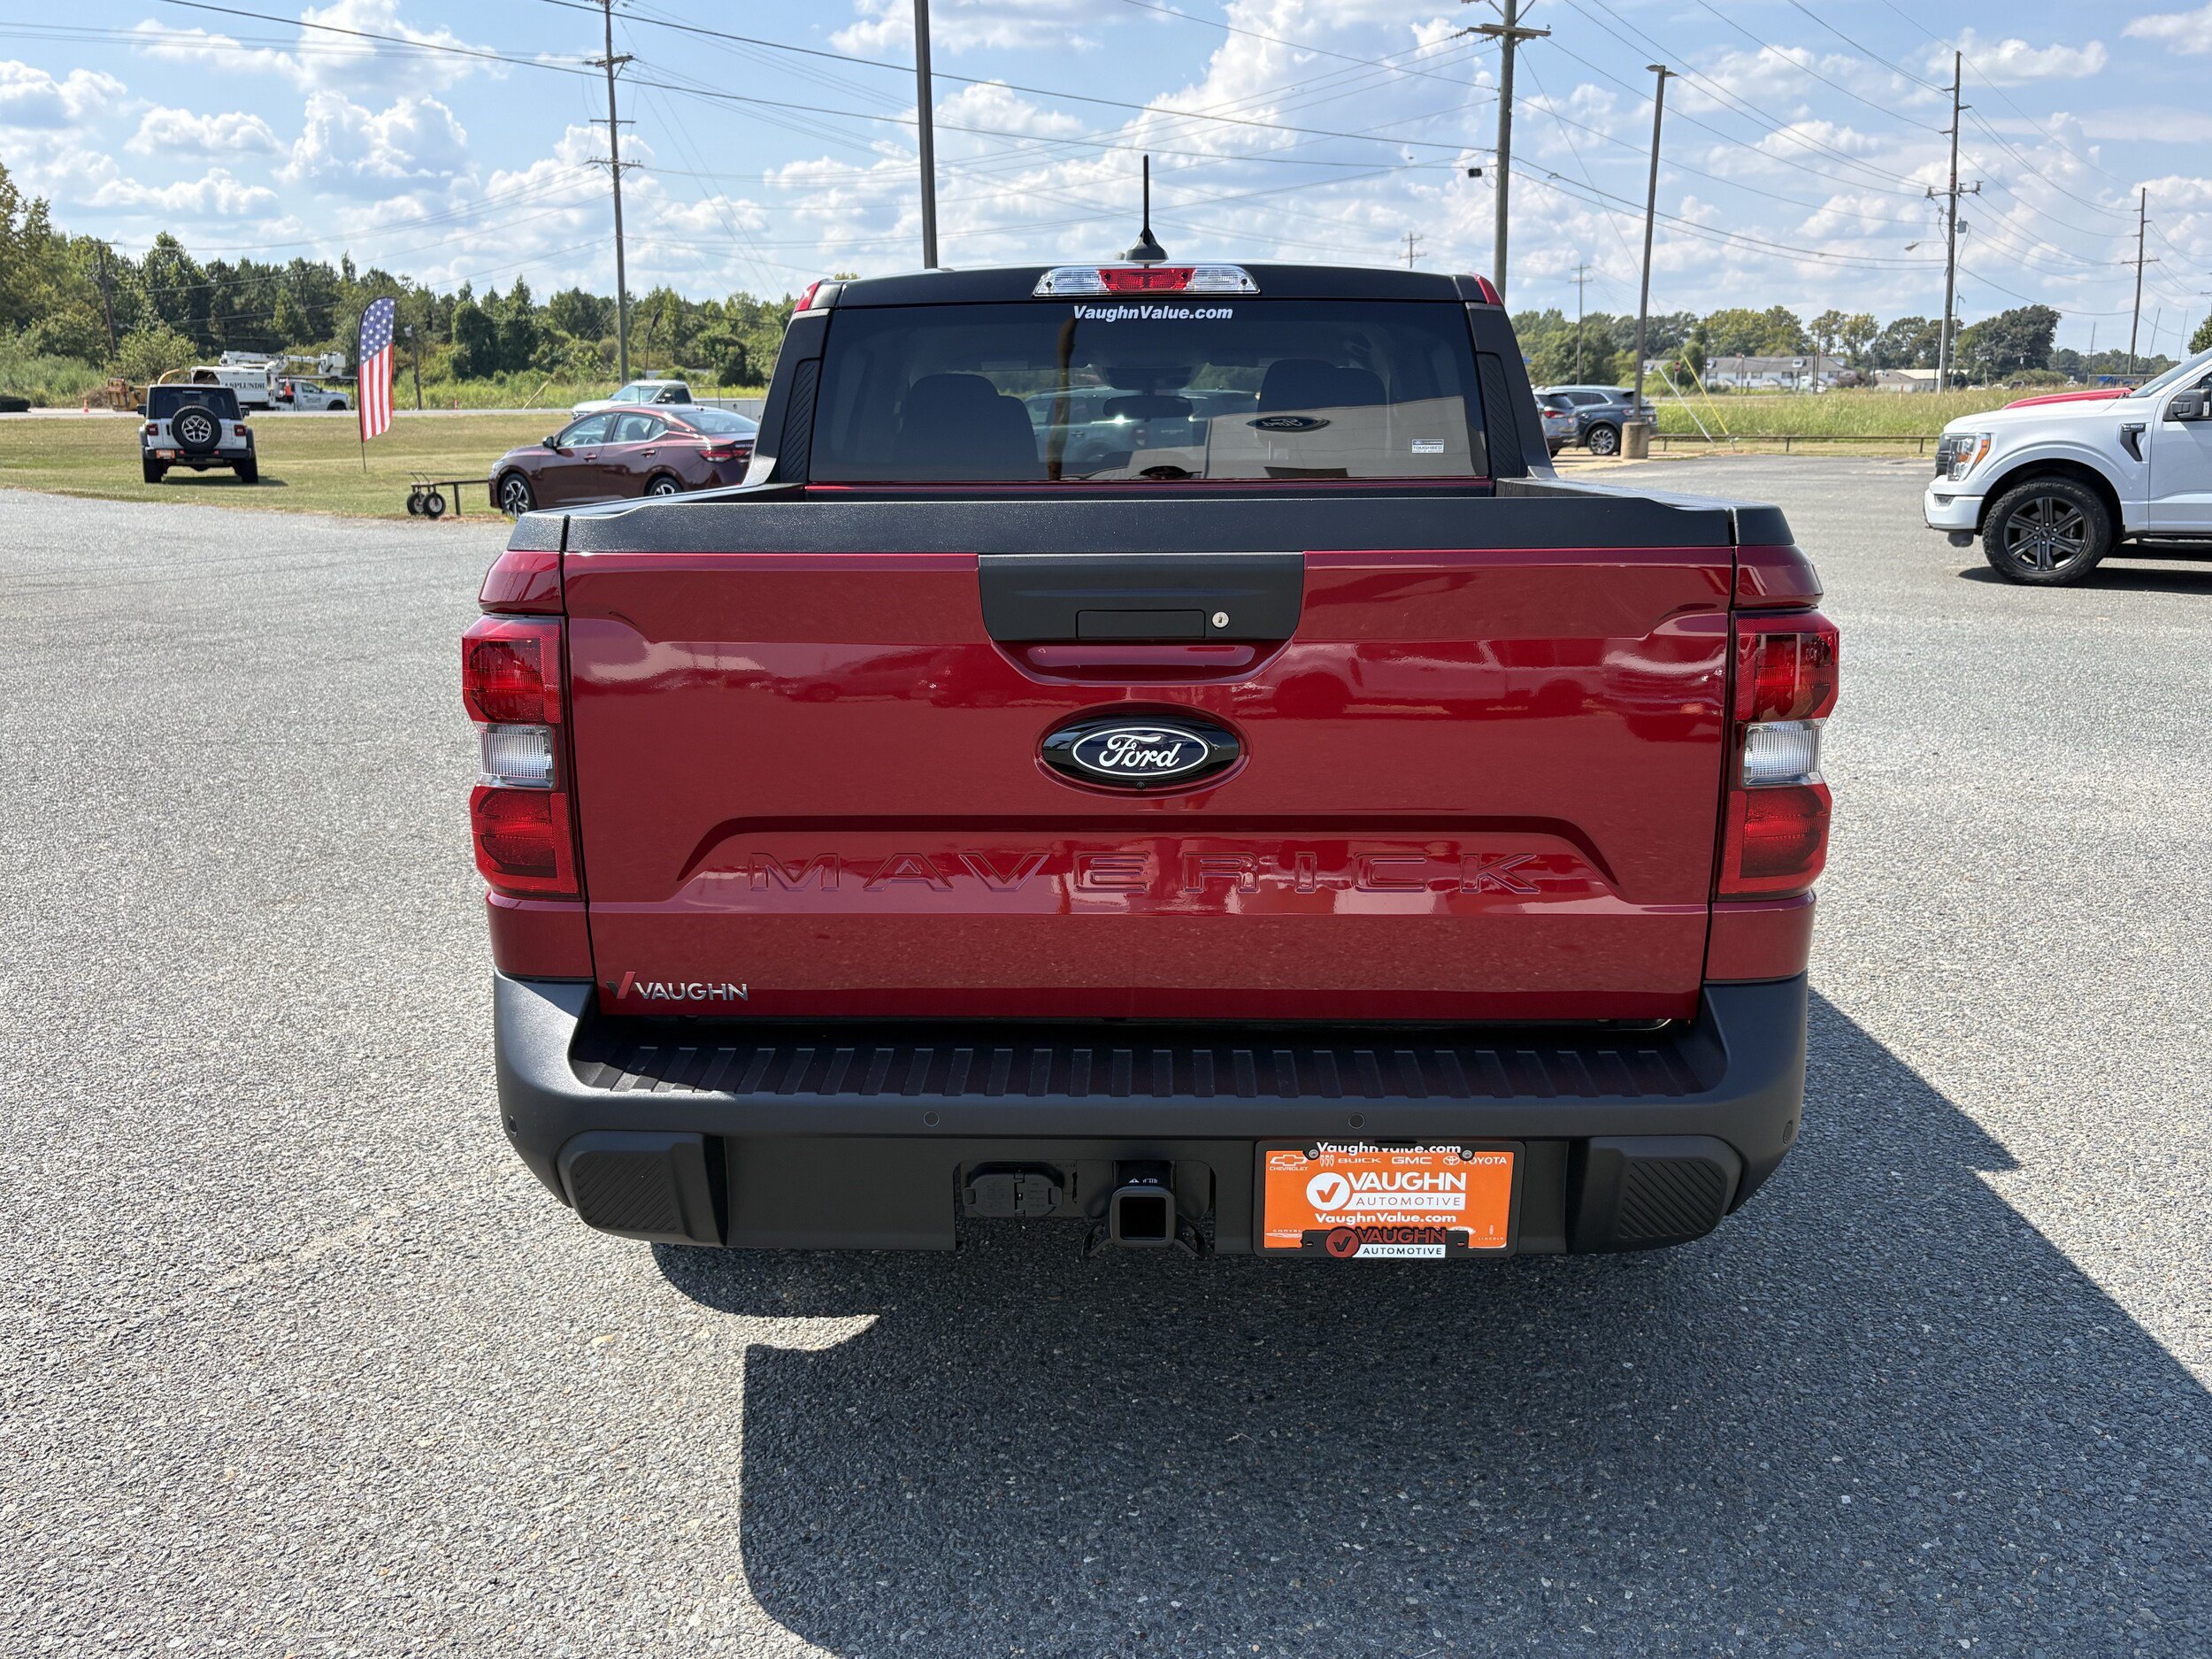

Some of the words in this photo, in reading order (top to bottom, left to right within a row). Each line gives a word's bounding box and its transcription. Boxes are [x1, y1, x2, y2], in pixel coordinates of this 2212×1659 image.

[1073, 305, 1233, 323] VaughnValue.com
[1098, 733, 1183, 768] Ford
[749, 851, 1541, 894] MAVERICK
[634, 981, 749, 1001] VAUGHN
[1347, 1171, 1467, 1191] VAUGHN
[1356, 1196, 1461, 1206] AUTOMOTIVE
[1315, 1212, 1457, 1225] VaughnValue.com
[1356, 1227, 1447, 1245] VAUGHN
